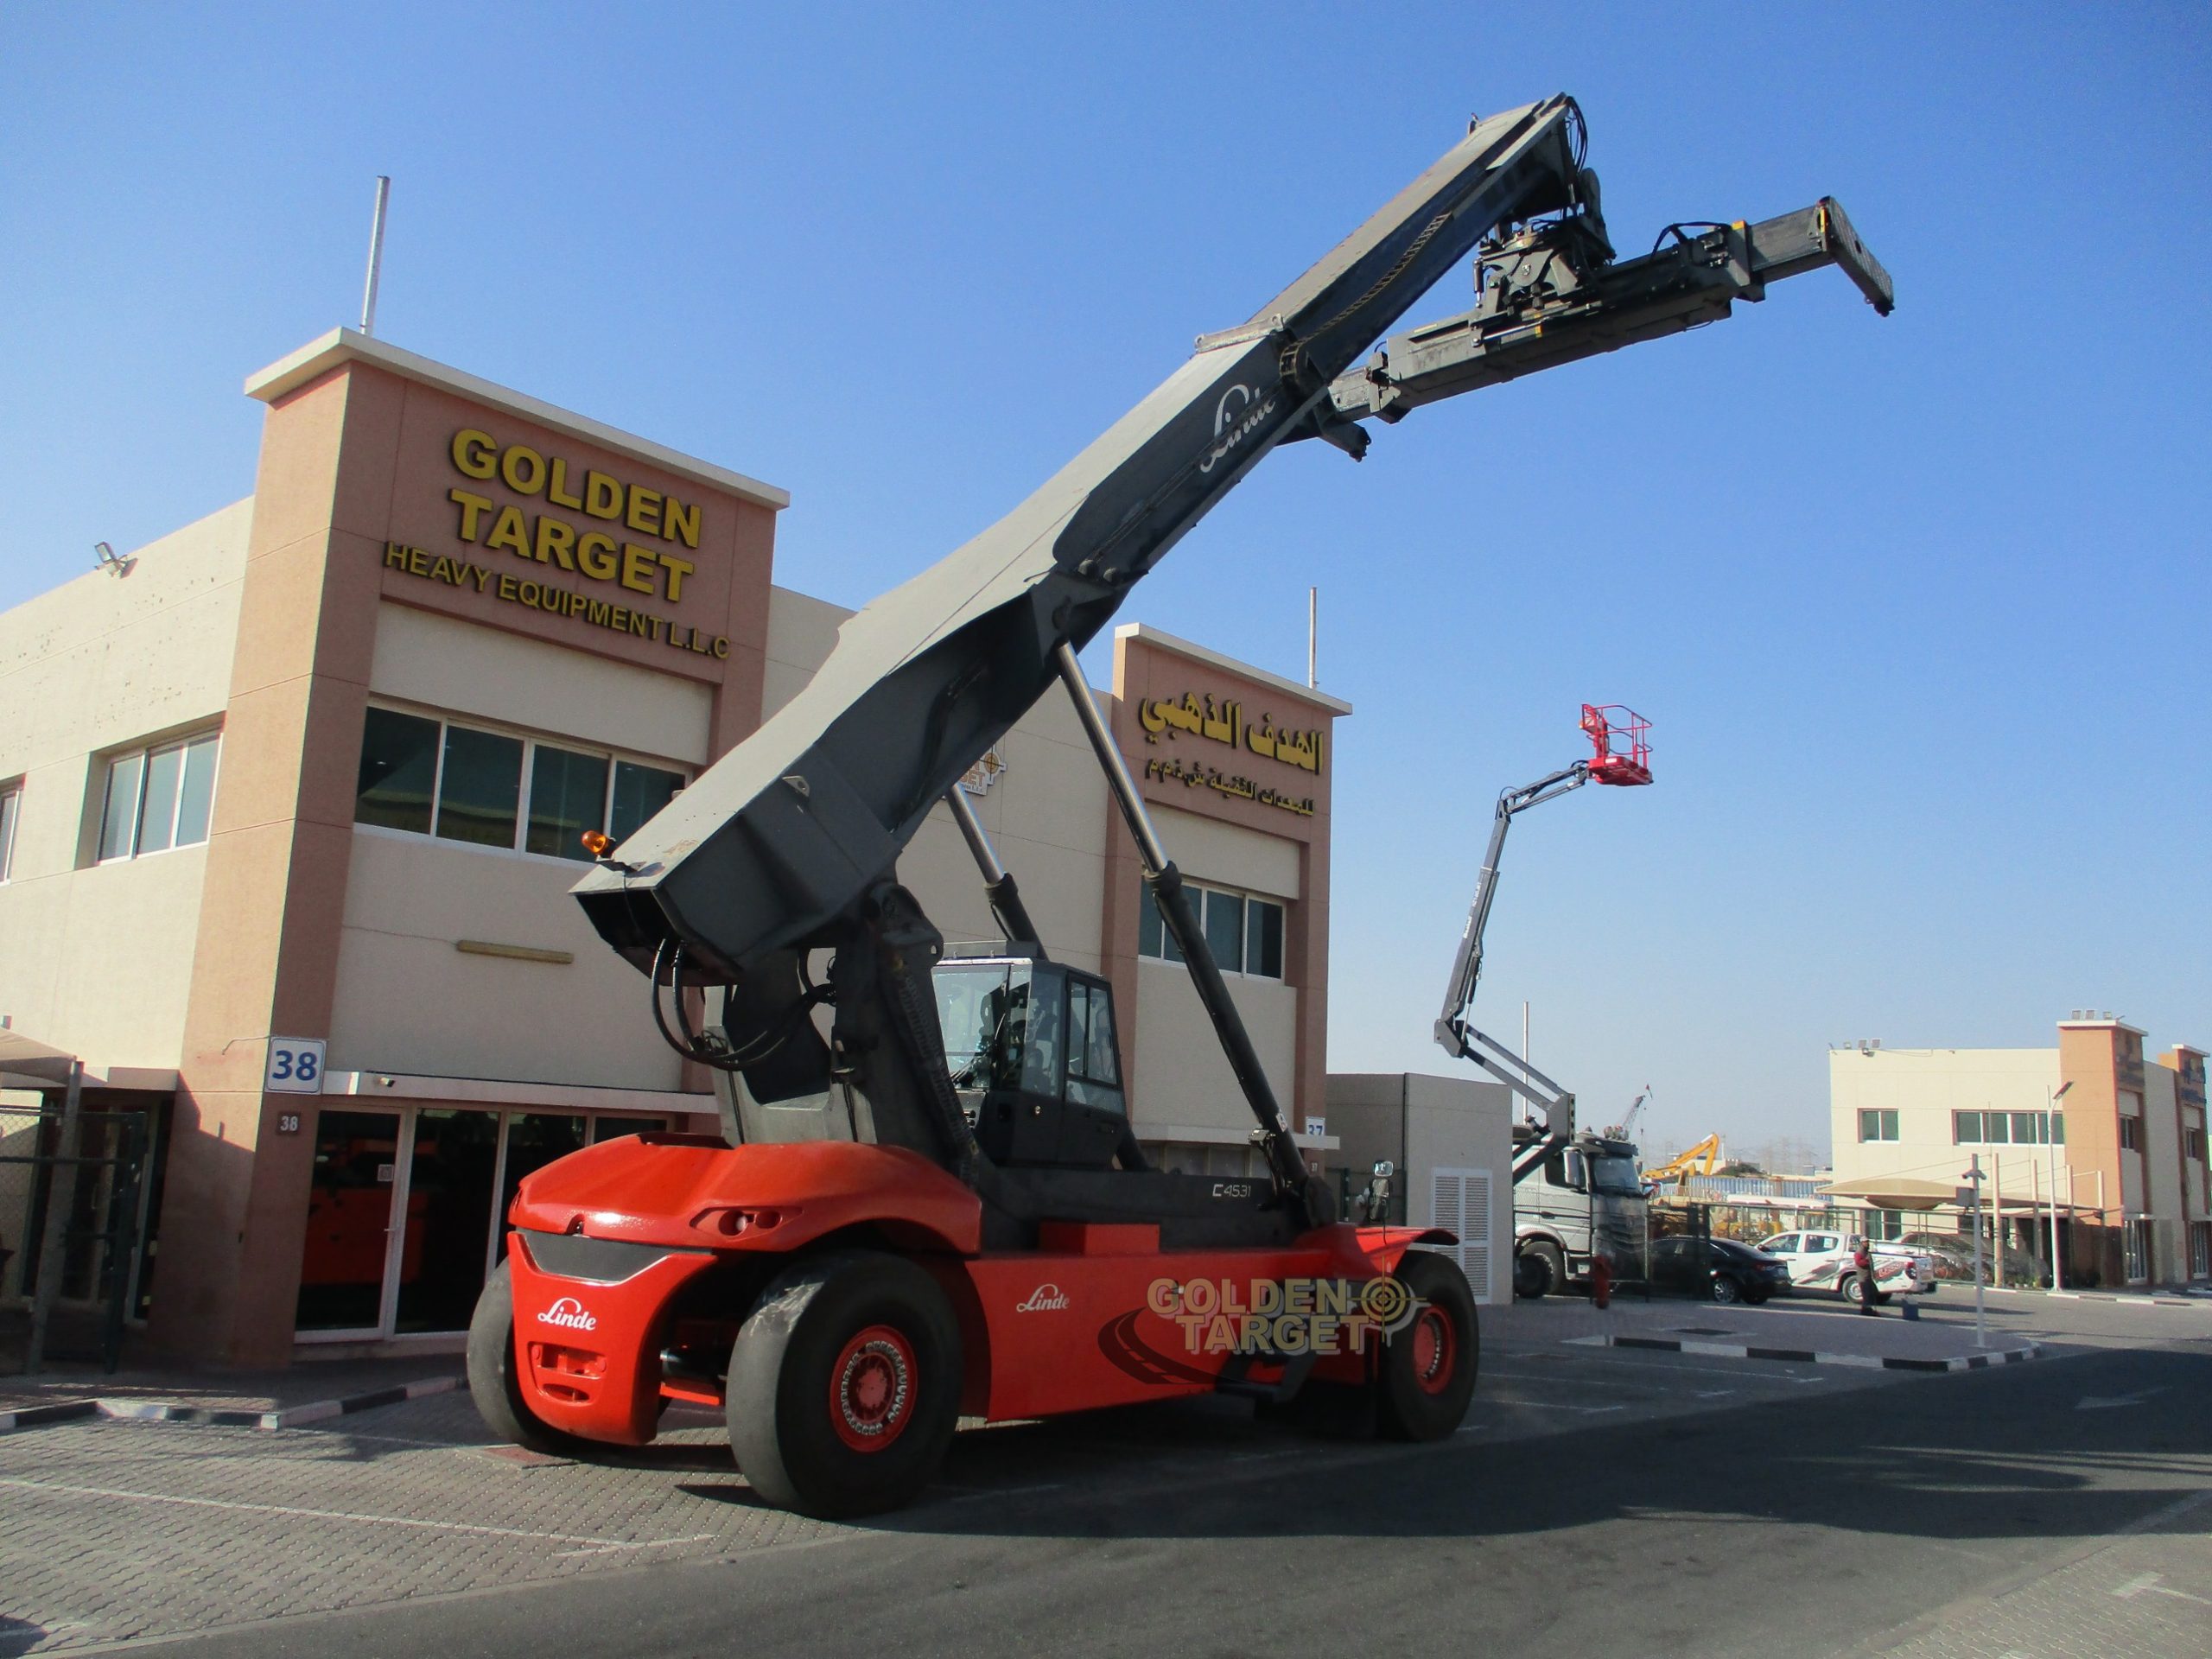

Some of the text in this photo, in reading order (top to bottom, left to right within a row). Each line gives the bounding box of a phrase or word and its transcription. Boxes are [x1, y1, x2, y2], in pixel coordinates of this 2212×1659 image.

[451, 429, 702, 548] GOLDEN
[448, 488, 694, 602] TARGET
[385, 541, 493, 593] HEAVY
[498, 573, 664, 639] EQUIPMENT
[1140, 692, 1324, 773] الهدف الذهبي
[272, 1050, 317, 1081] 38
[280, 1116, 298, 1131] 38
[537, 1297, 596, 1331] Linde
[1016, 1283, 1070, 1313] Linde
